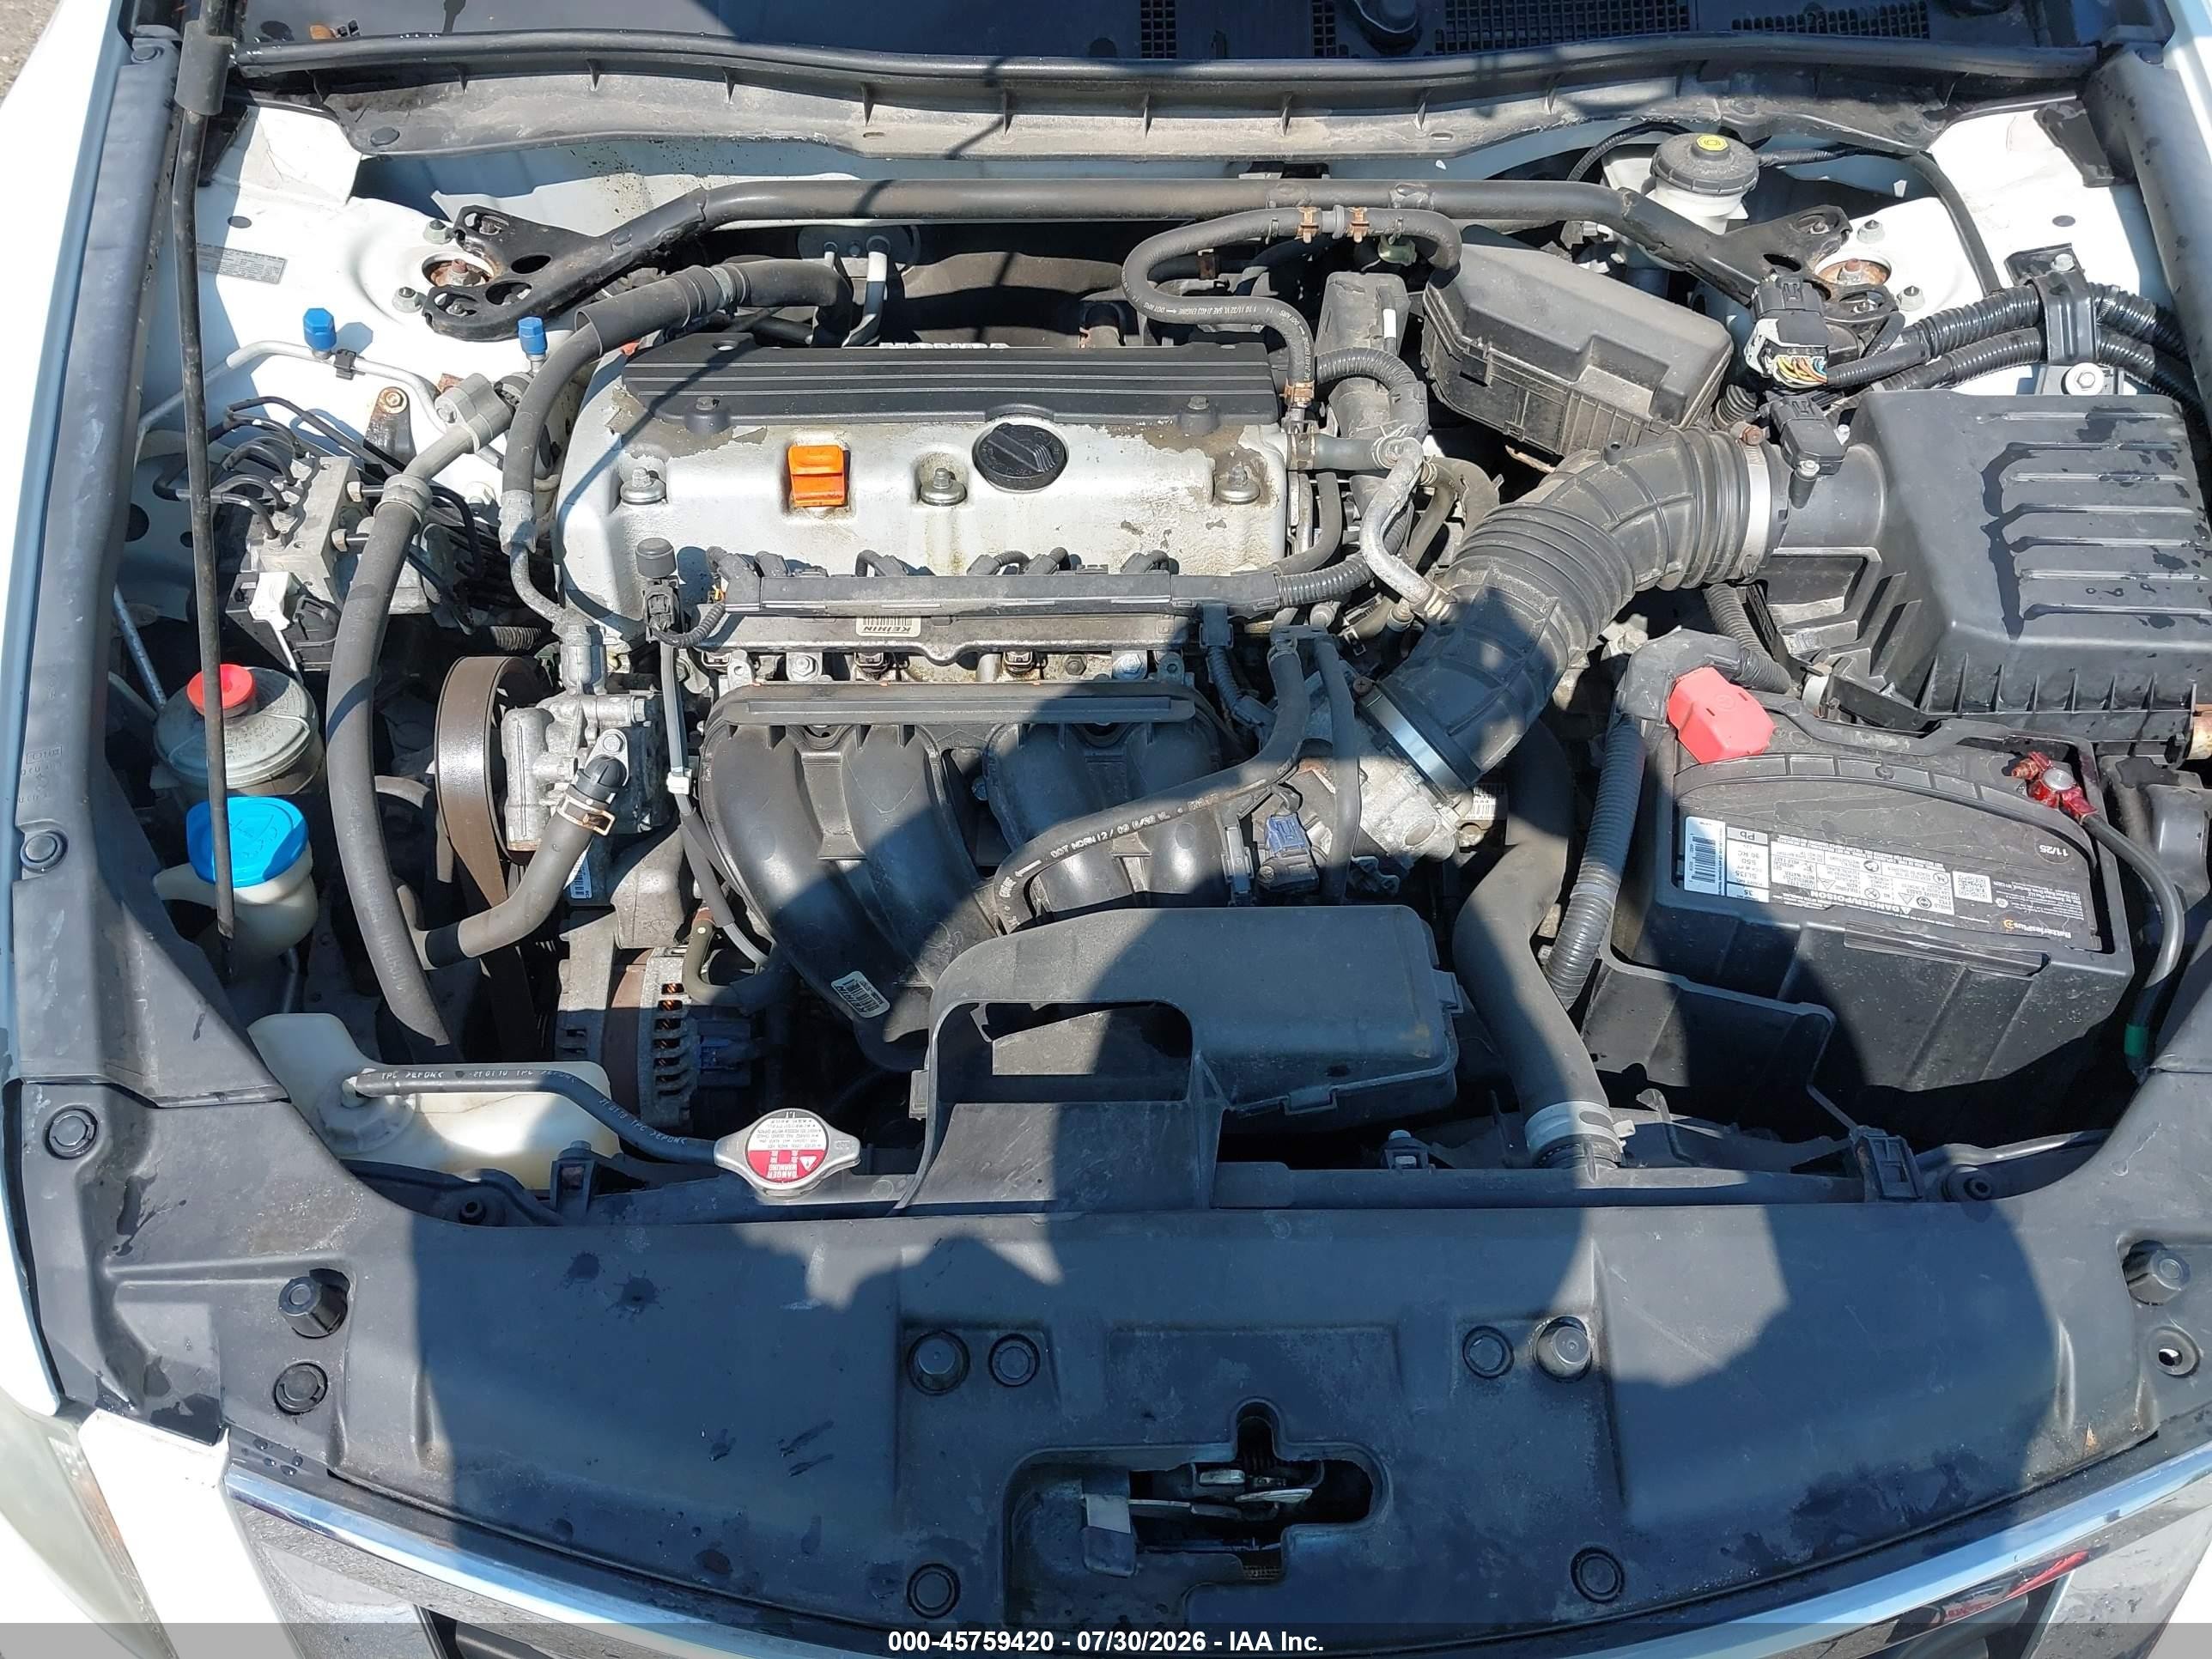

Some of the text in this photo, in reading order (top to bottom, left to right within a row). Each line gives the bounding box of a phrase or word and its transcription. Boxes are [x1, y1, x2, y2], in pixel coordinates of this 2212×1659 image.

[1740, 831, 1755, 842] Pb
[1050, 845, 1070, 859] DOT
[2039, 844, 2069, 858] 11/25
[1810, 890, 1900, 913] DANGER/POISON
[2012, 922, 2072, 939] BatteriesPlus
[766, 1170, 798, 1179] DANGER
